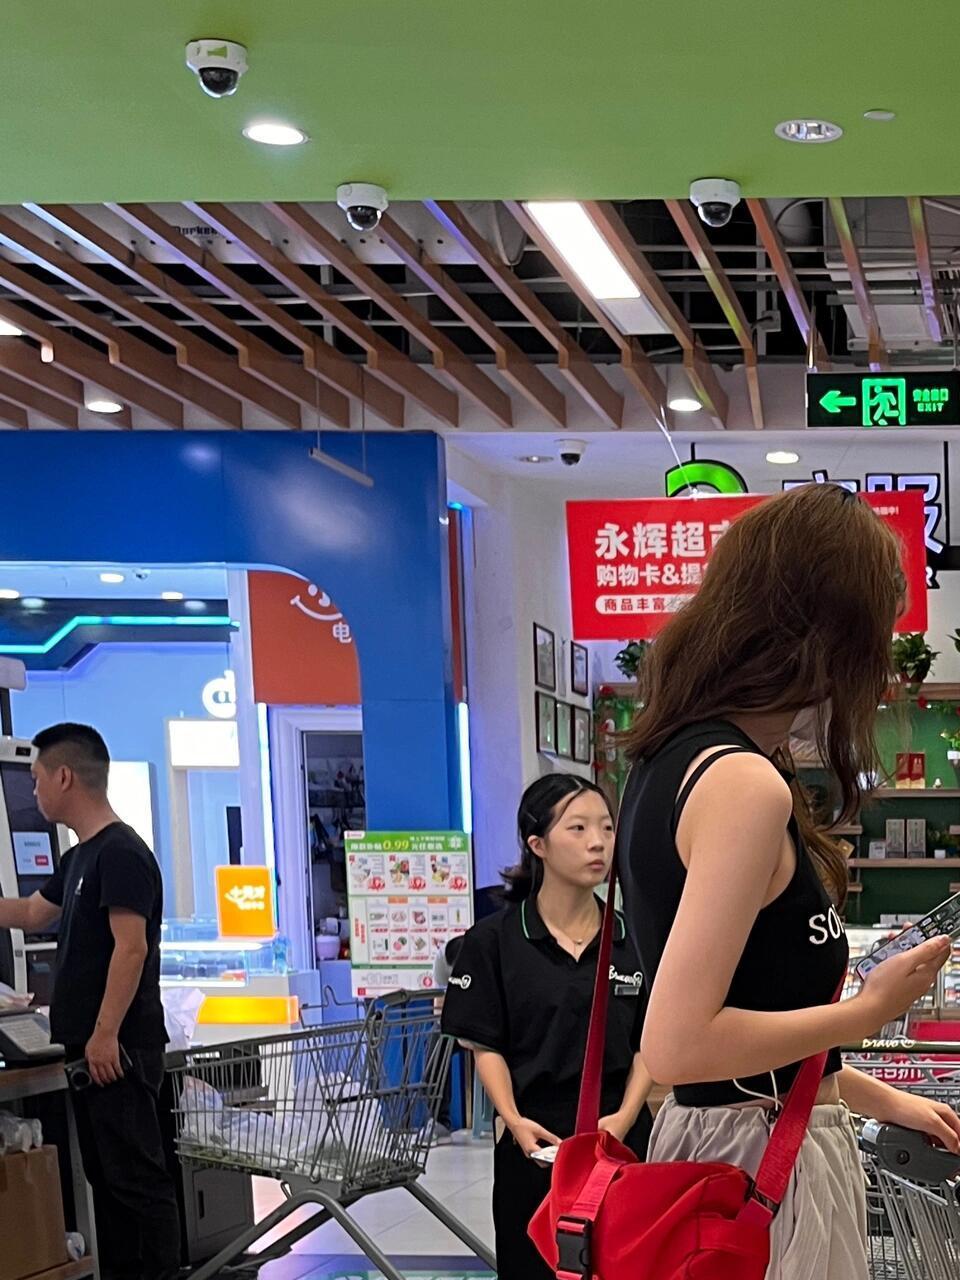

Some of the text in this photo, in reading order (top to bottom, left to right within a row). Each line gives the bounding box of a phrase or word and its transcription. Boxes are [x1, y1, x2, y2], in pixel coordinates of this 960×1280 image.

[917, 402, 944, 412] EXIT
[596, 563, 708, 588] 购物卡&提
[332, 621, 352, 643] 电
[383, 840, 409, 850] 0.99
[808, 904, 845, 945] SO
